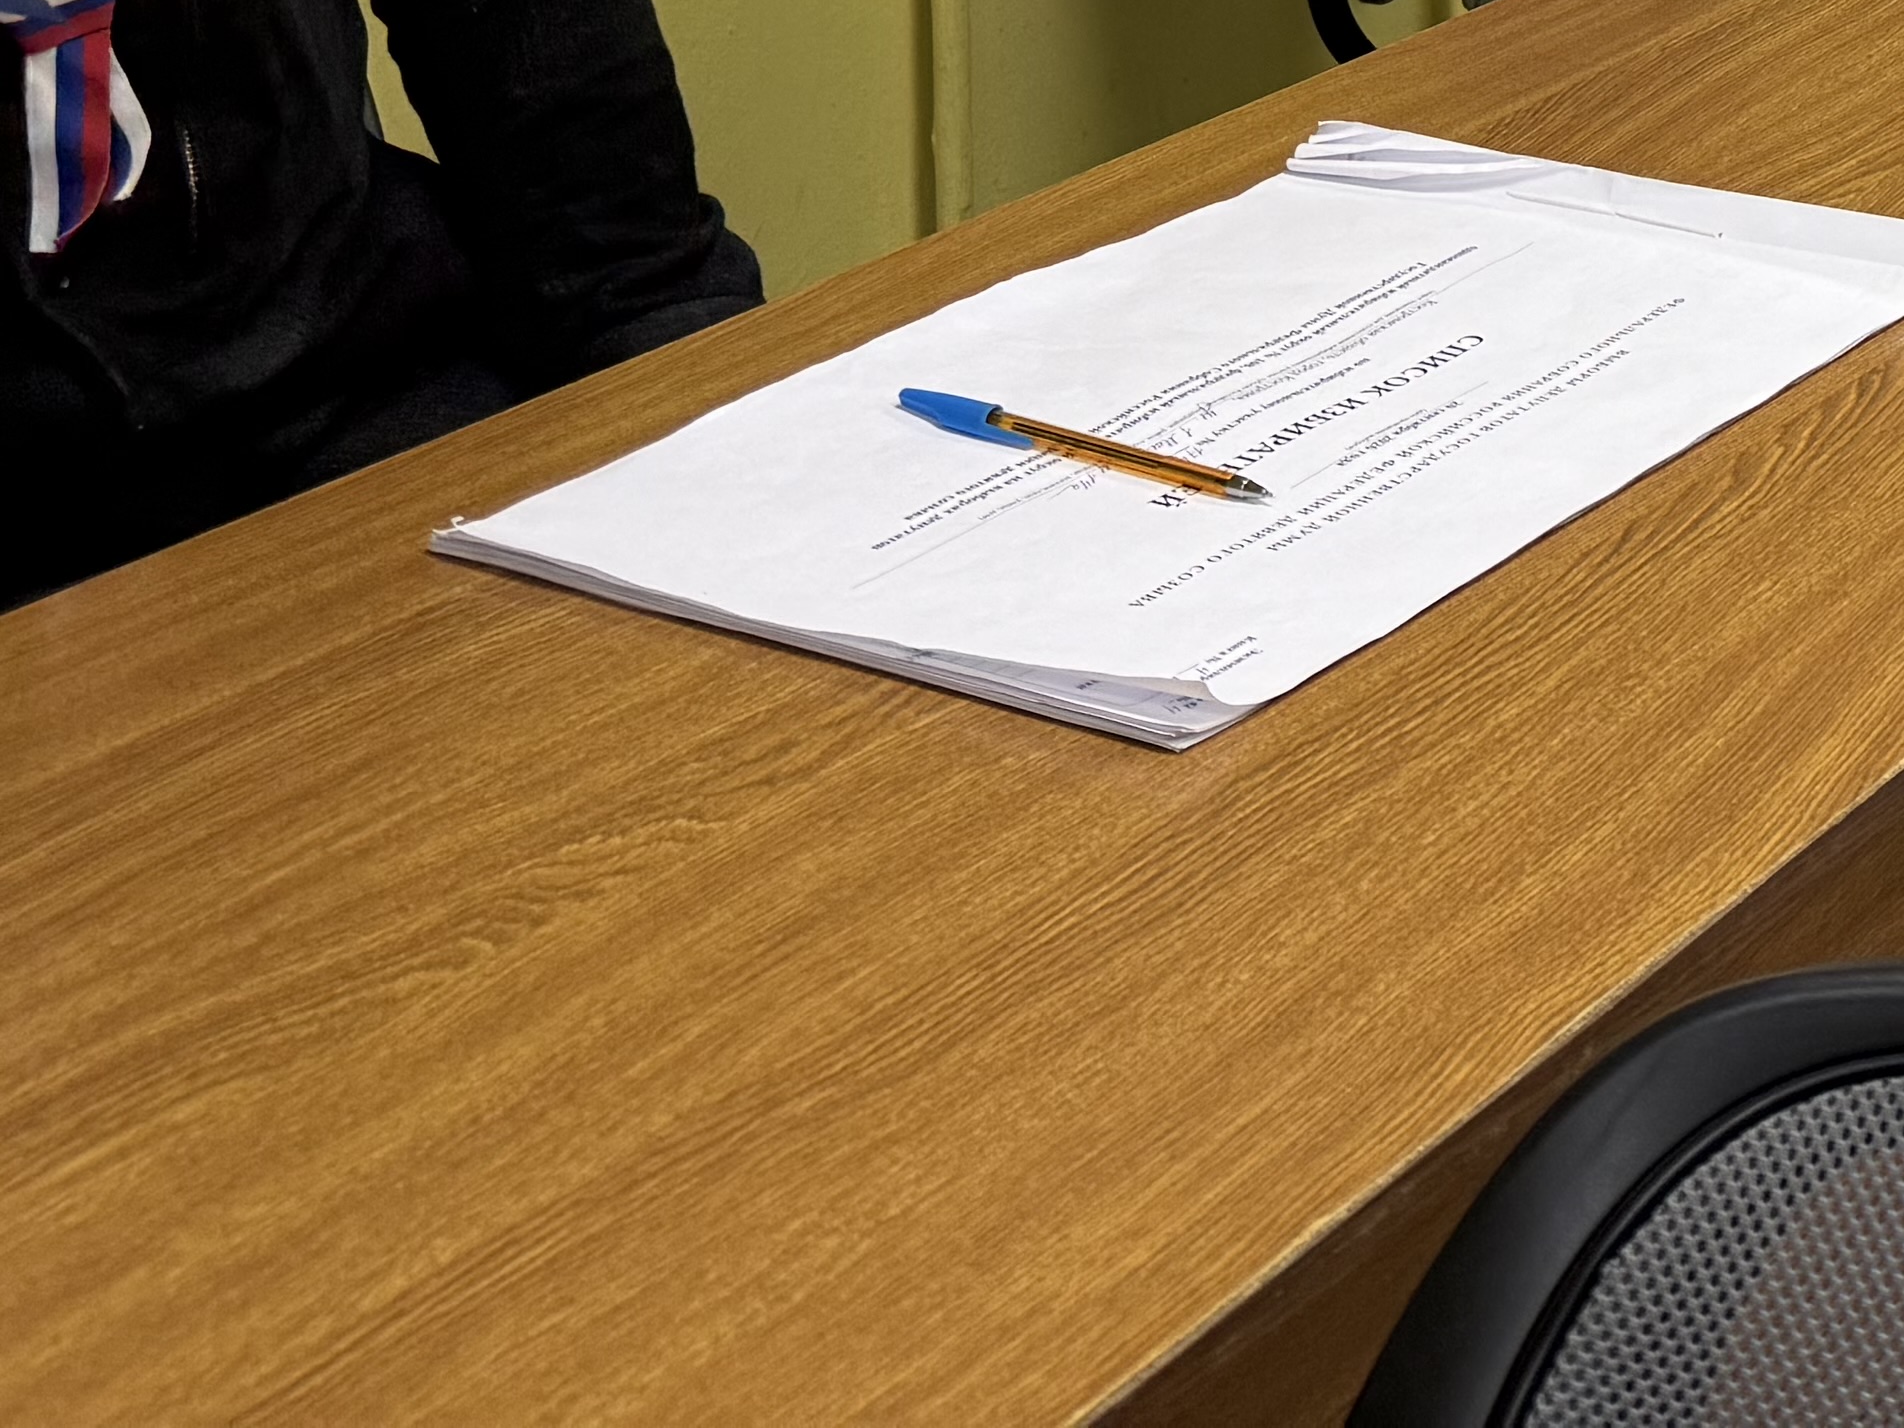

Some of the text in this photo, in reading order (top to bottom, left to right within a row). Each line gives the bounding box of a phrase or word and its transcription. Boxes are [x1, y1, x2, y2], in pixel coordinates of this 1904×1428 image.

[1359, 335, 1484, 398] СПИСОК
[1500, 360, 1580, 402] СОБРАНИЯ
[1394, 401, 1504, 458] РОССИЙСКОЙ
[1478, 385, 1567, 432] ДЕПУТАТОВ
[1148, 397, 1370, 510] ИЗБИРАТЕЕЙ
[1321, 432, 1481, 523] ГОСУДАРСТВЕННОЙ
[1296, 459, 1396, 516] ФЕДЕРАЦИИ
[1206, 515, 1298, 563] ДЕВЯТОГО
[1266, 521, 1322, 552] ДУМЫ
[1127, 565, 1206, 607] СОЗЫВА
